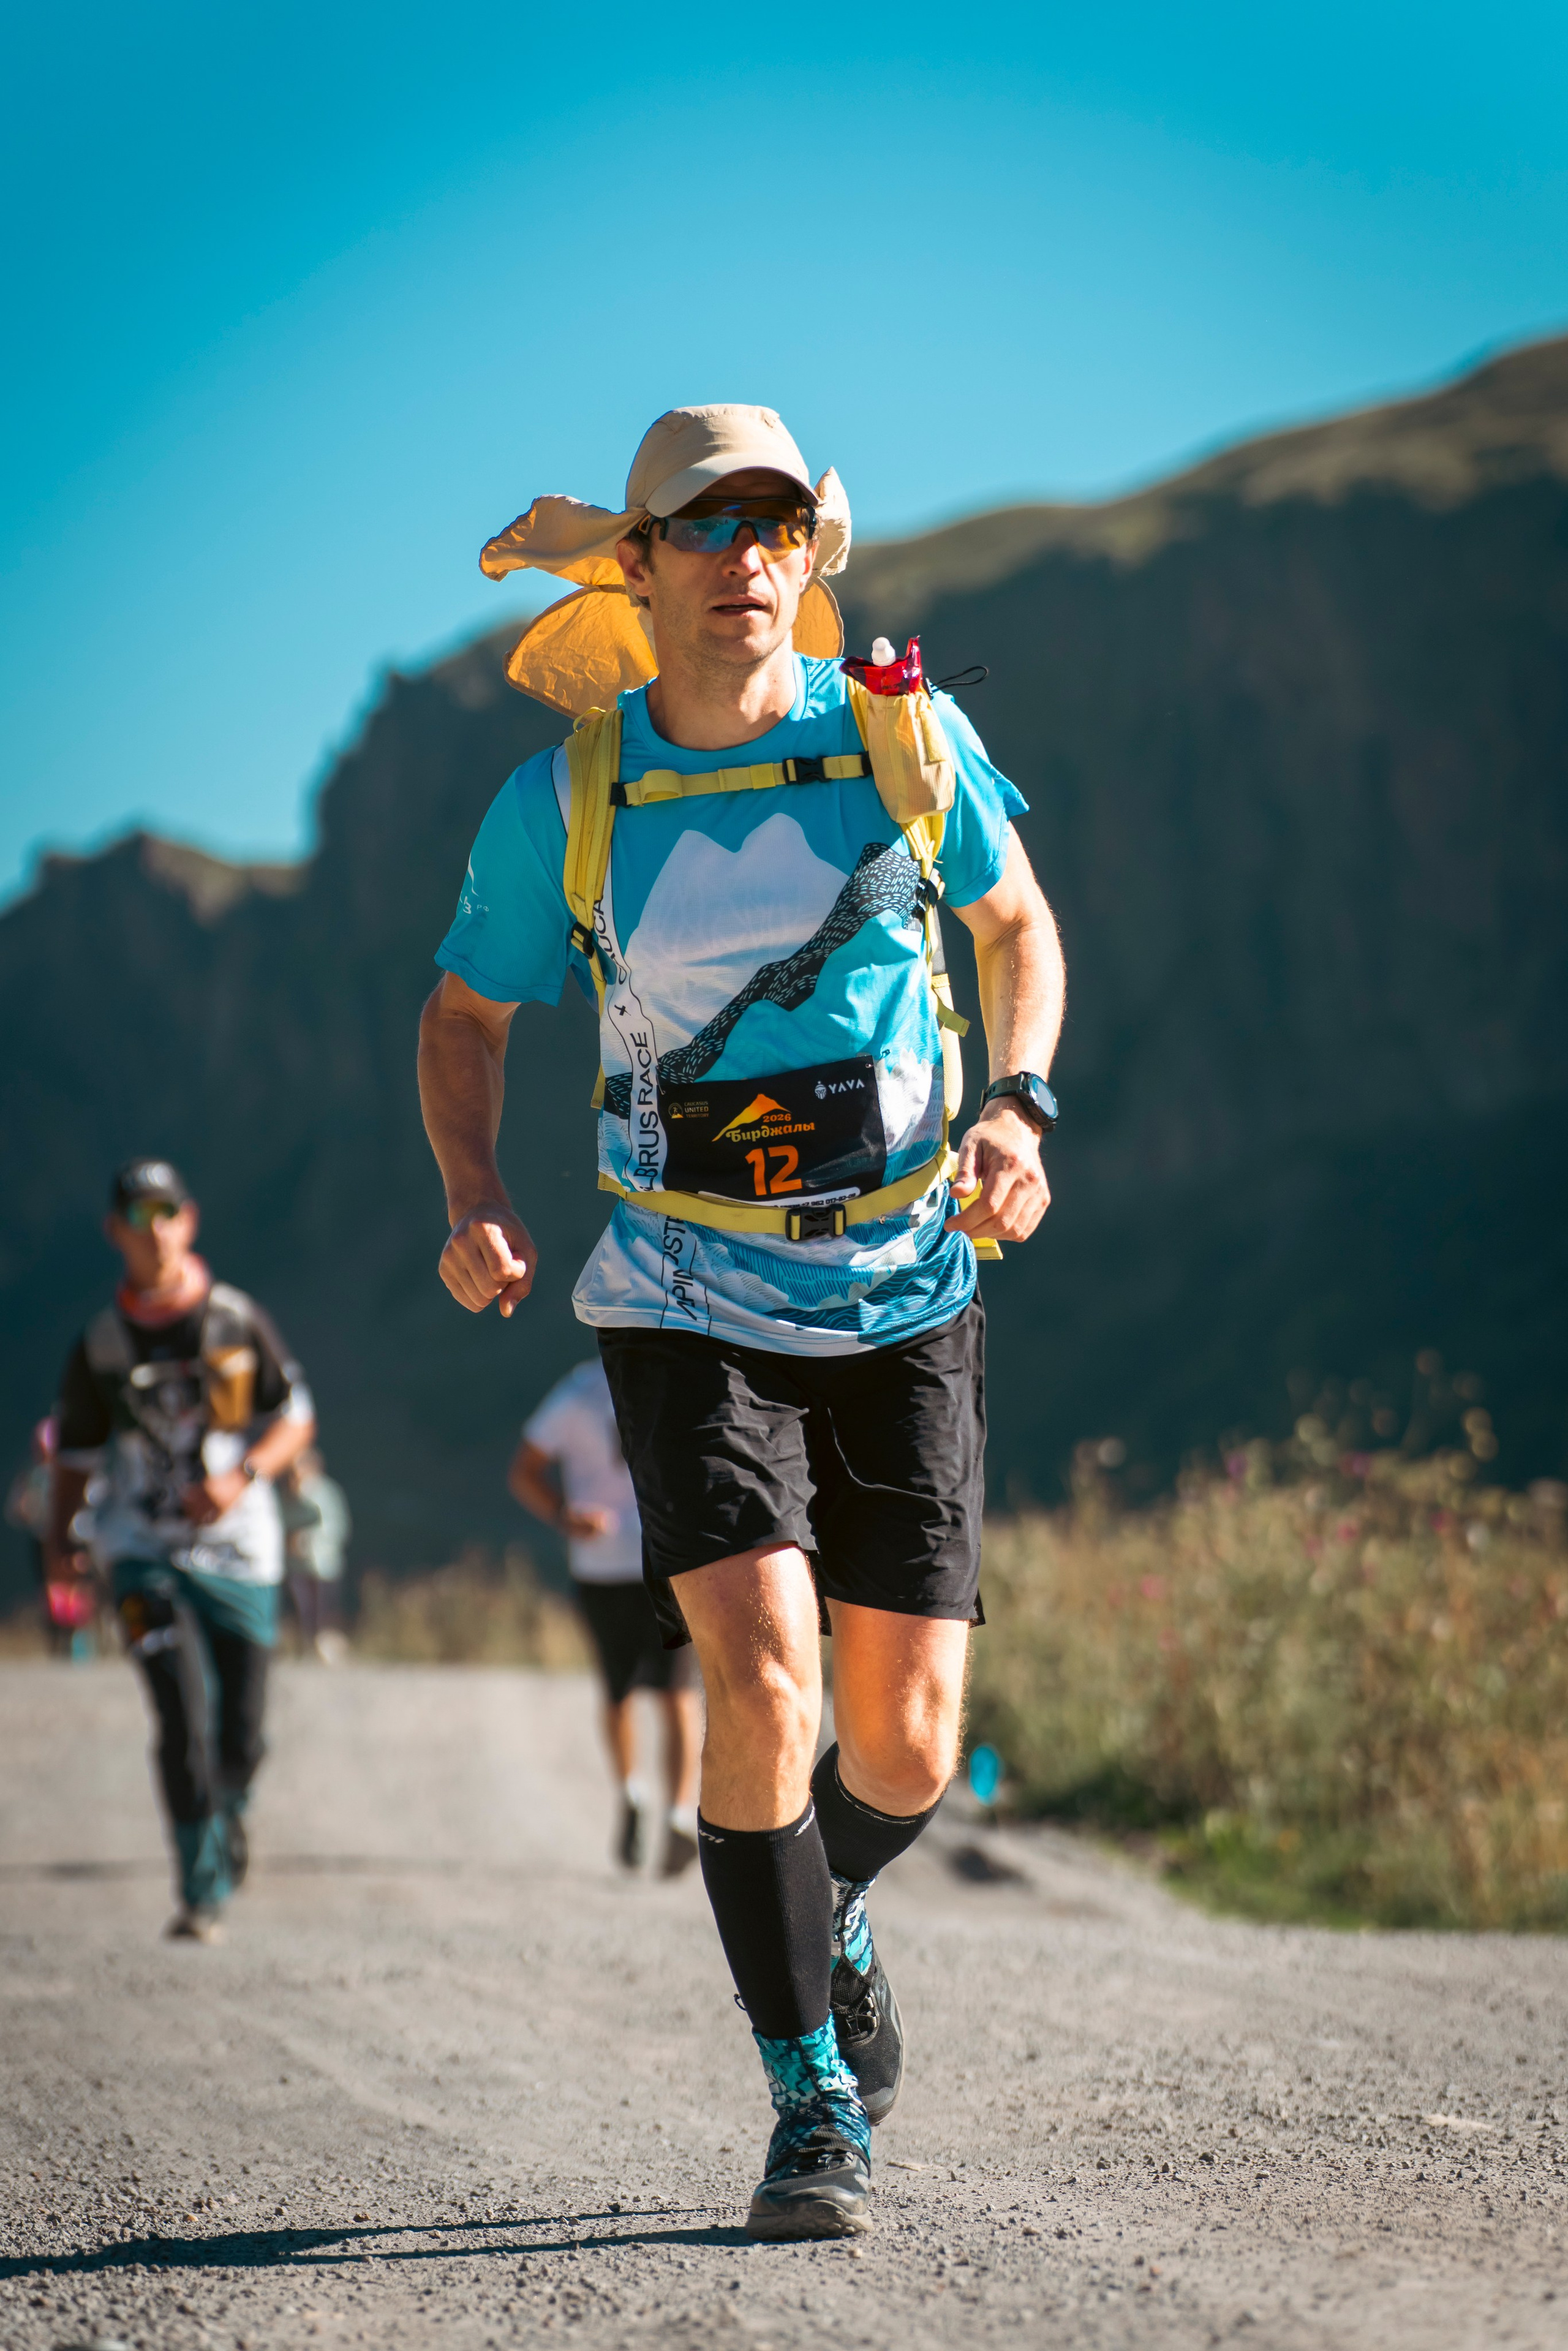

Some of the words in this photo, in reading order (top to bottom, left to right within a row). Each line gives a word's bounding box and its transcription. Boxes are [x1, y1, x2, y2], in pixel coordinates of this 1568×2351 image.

[631, 1031, 653, 1105] RACE
[828, 1079, 865, 1094] YAVA
[763, 1113, 791, 1123] 2026
[725, 1122, 815, 1142] Бирджалы
[745, 1145, 802, 1196] 12
